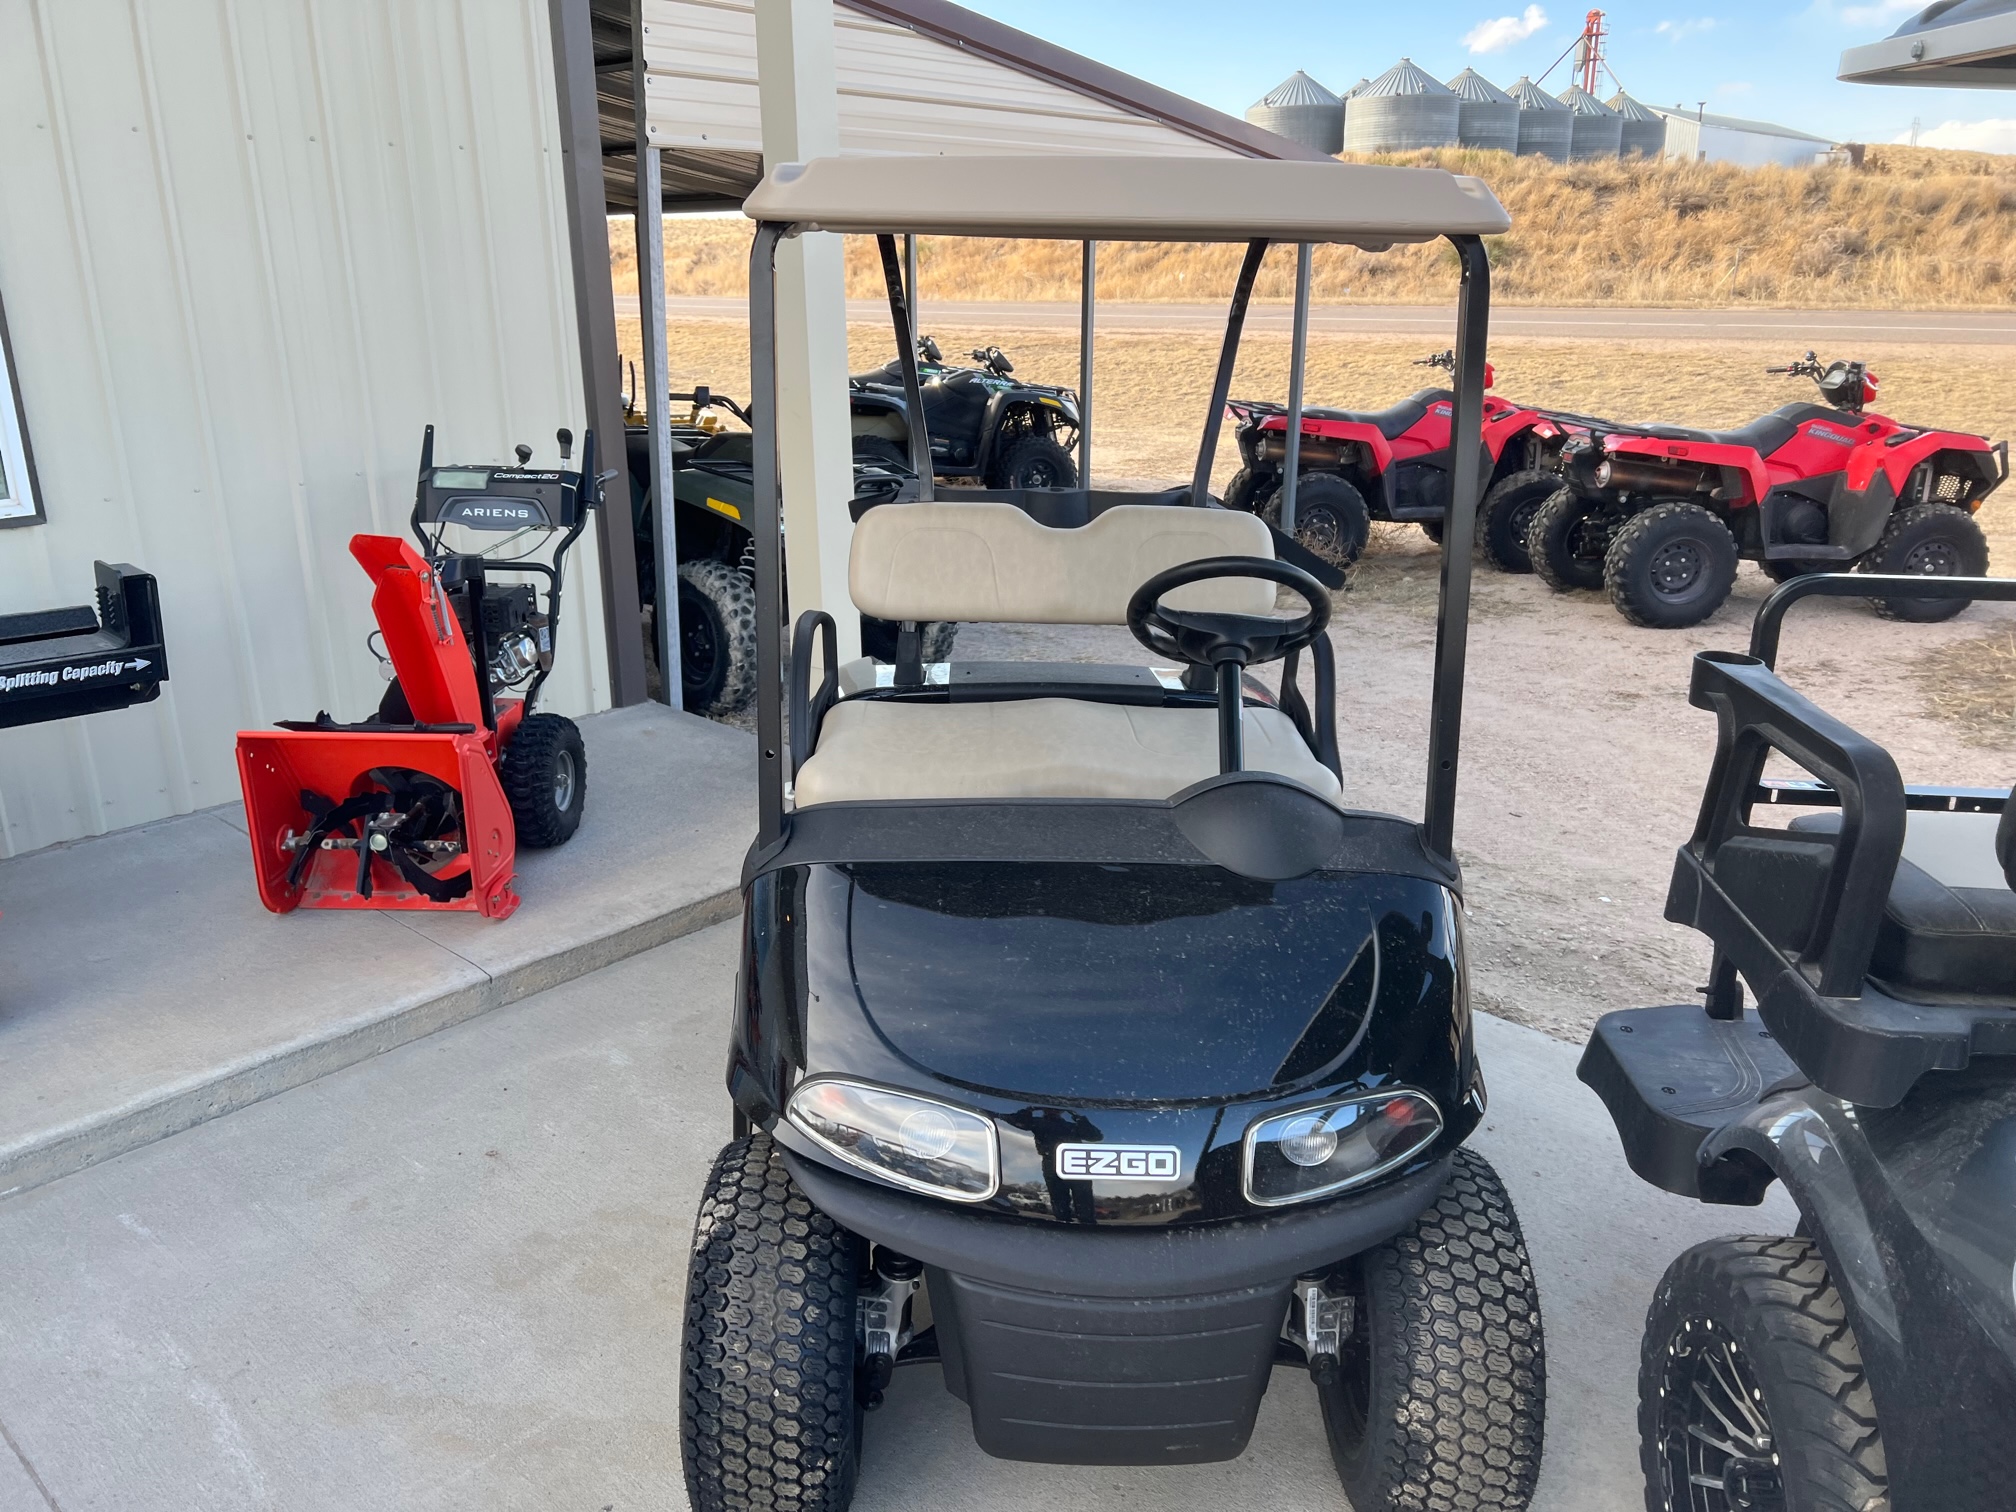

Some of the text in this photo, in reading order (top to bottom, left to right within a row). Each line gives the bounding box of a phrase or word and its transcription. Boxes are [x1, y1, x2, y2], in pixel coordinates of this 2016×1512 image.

[462, 507, 529, 518] ARIENS
[0, 660, 124, 692] Splitting Capacity
